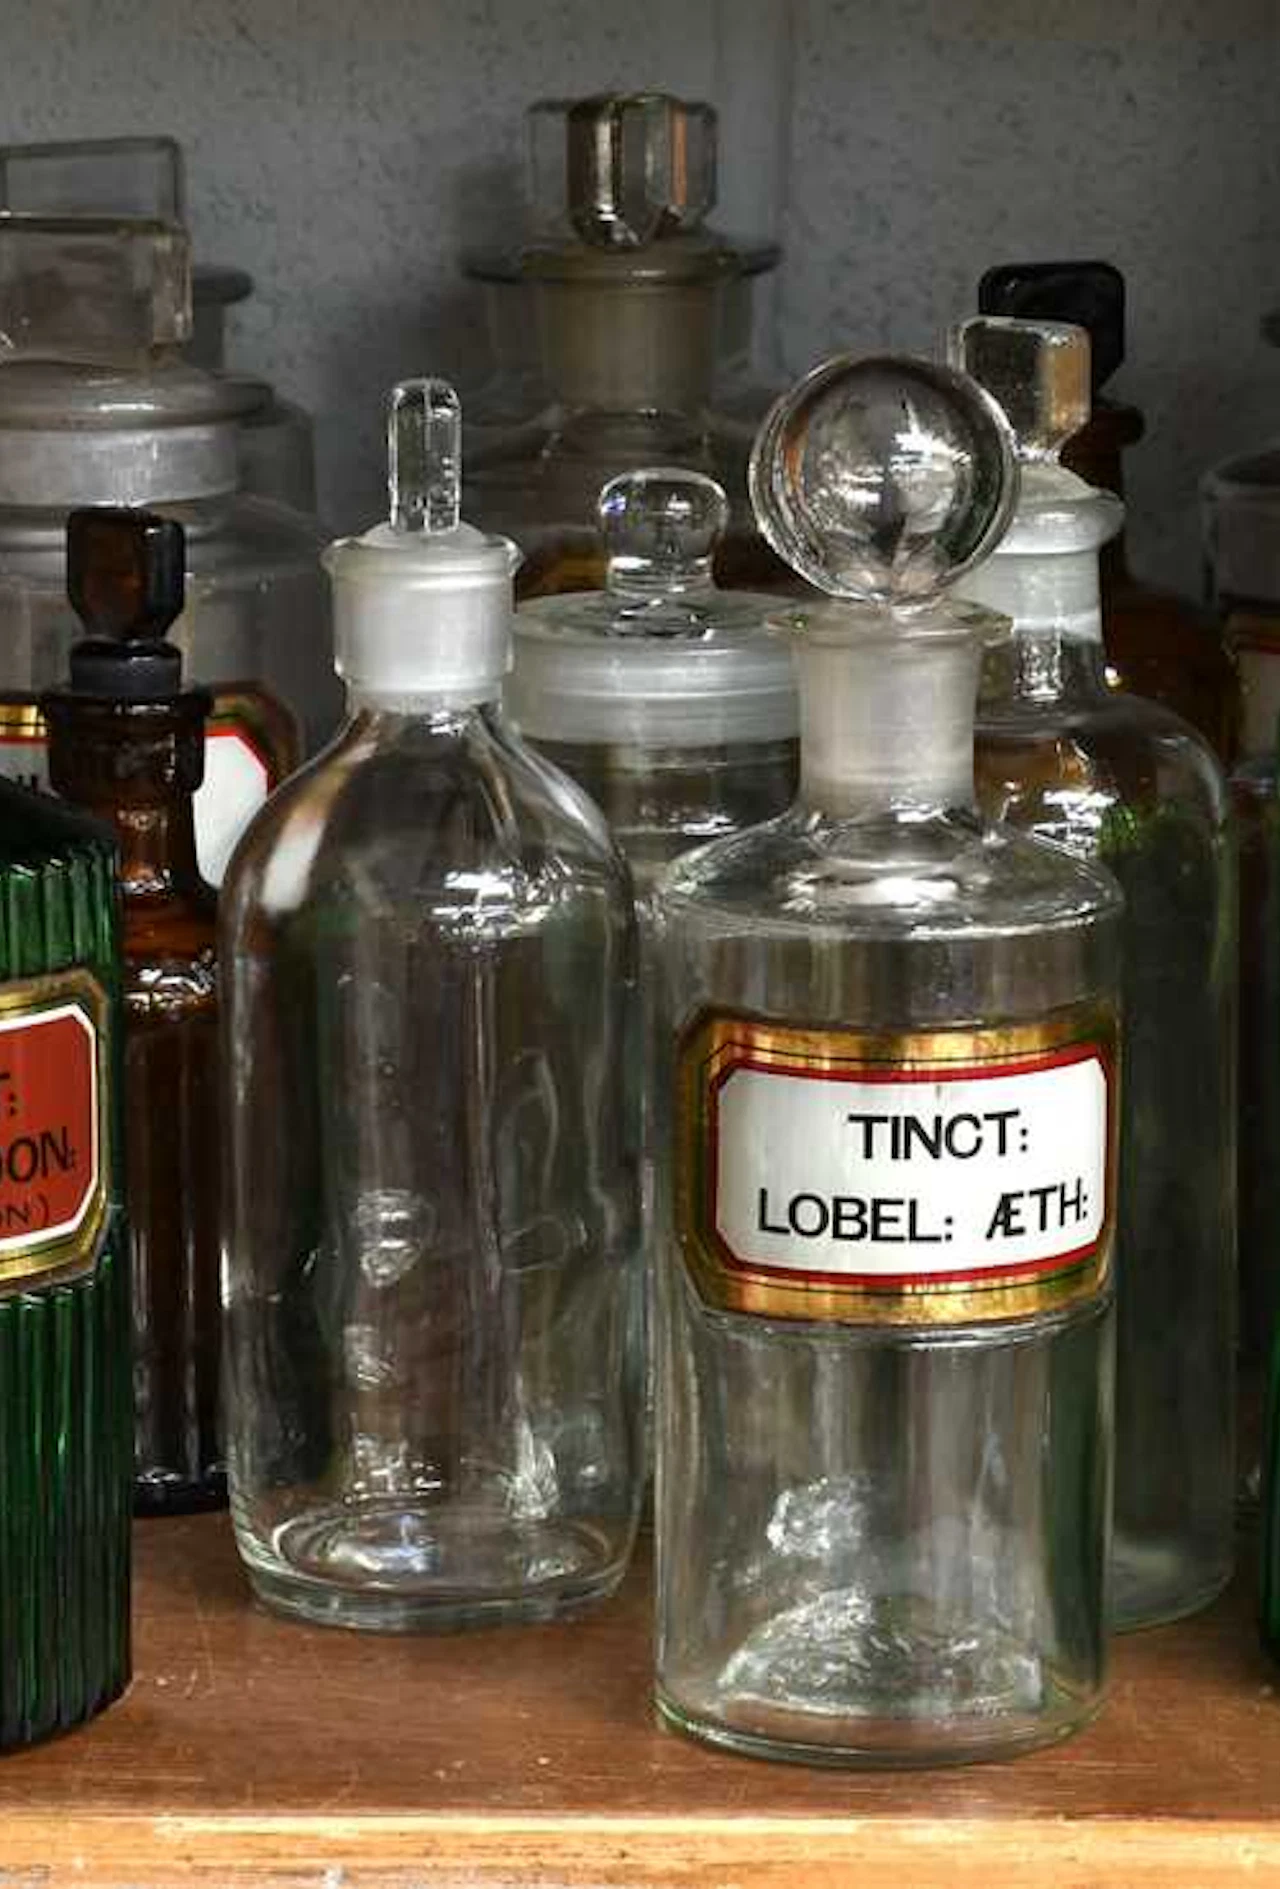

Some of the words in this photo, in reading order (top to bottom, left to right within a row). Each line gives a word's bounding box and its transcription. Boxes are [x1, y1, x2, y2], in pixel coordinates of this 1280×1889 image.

[847, 1108, 1029, 1161] TINCT:
[758, 1188, 954, 1243] LOBEL:
[985, 1177, 1089, 1242] ÆTH:
